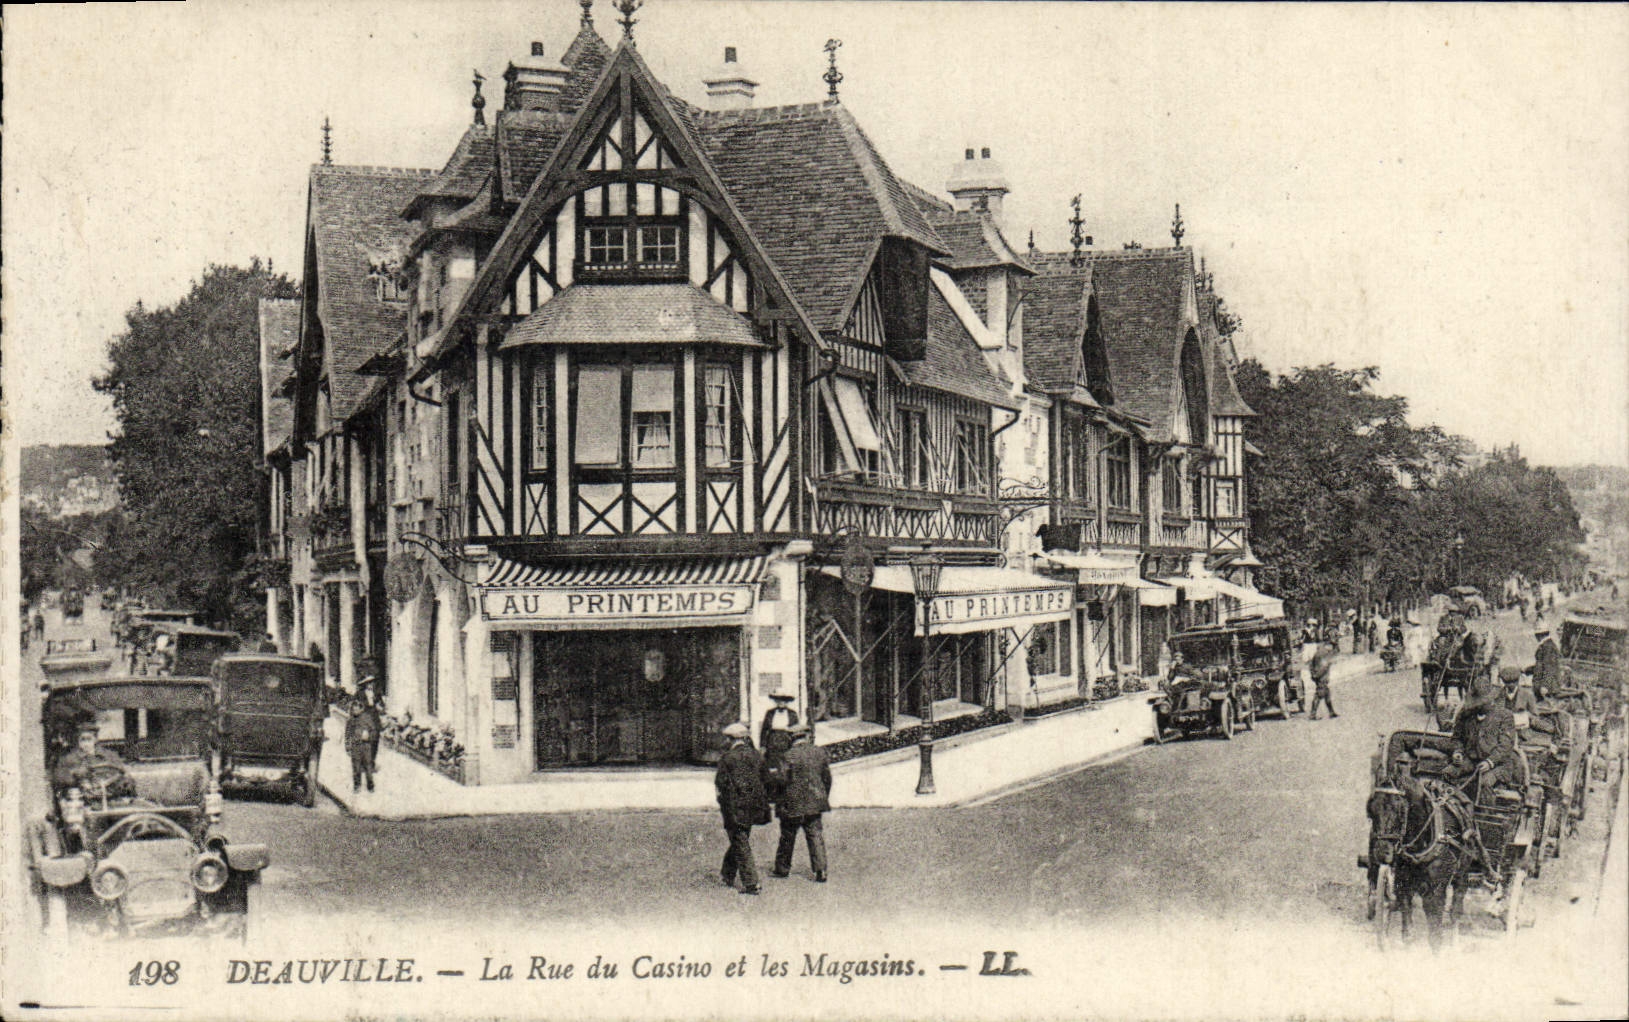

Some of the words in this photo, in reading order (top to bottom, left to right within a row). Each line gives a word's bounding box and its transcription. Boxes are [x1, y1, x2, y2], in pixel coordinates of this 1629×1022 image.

[502, 594, 540, 614] AU
[568, 591, 736, 614] PRINTEMPS
[931, 600, 954, 621] AU
[965, 592, 1065, 618] PRINTEMPS
